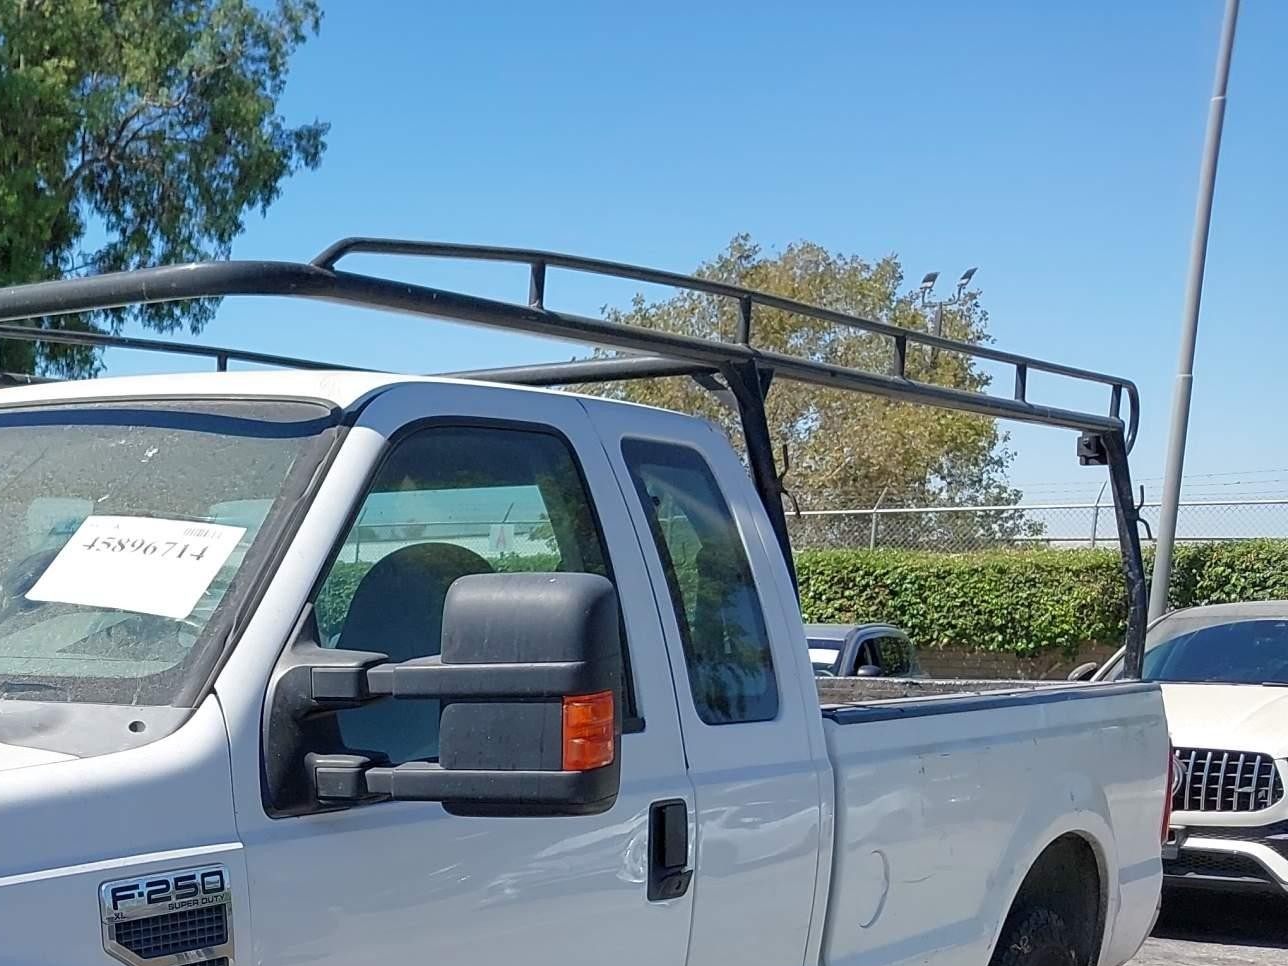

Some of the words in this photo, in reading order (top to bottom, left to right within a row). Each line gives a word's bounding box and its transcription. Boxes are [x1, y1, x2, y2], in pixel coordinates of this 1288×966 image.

[82, 535, 210, 561] 45896714
[111, 869, 225, 911] F-250
[168, 899, 199, 911] SUPER
[201, 894, 225, 906] DUTY
